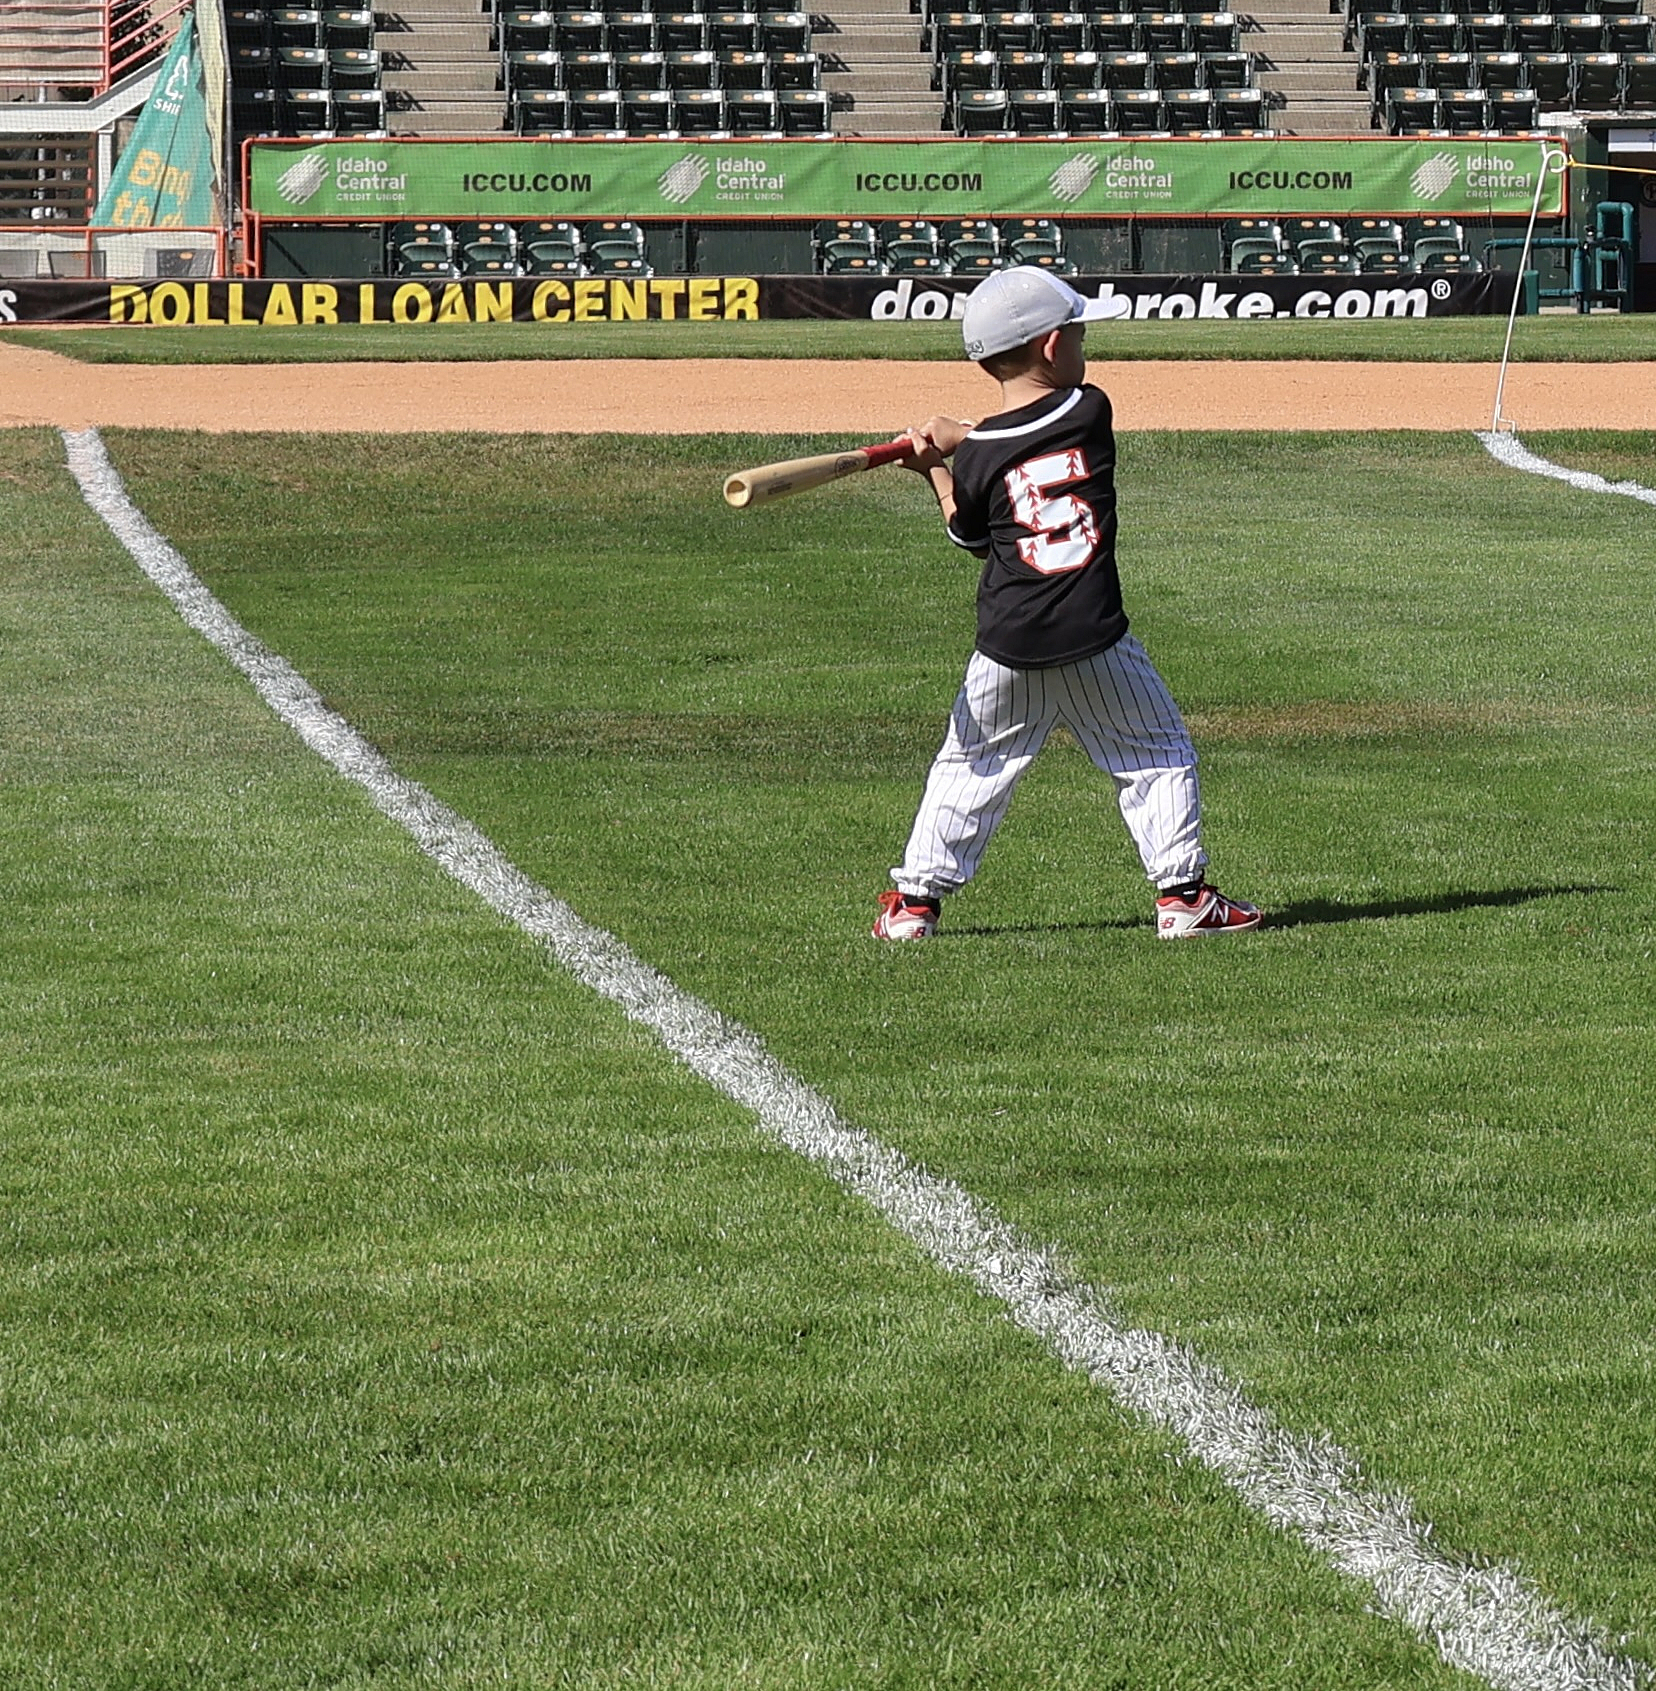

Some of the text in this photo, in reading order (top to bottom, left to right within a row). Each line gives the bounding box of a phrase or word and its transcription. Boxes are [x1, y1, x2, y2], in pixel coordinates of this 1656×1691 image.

[336, 156, 388, 173] Idaho
[716, 156, 767, 173] Idaho
[1105, 155, 1155, 171] Idaho
[1467, 155, 1515, 171] Idaho
[336, 173, 406, 191] Central
[463, 173, 592, 193] ICCU.COM
[716, 173, 785, 190] Central
[856, 173, 983, 192] ICCU.COM
[1105, 171, 1173, 189] Central
[1229, 171, 1353, 191] ICCU.COM
[1467, 171, 1532, 189] Central
[336, 193, 406, 202] CREDIT UNION
[1105, 190, 1173, 200] CREDIT UNION
[109, 278, 760, 325] DOLLAR LOAN CENTER
[1004, 447, 1100, 575] 5
